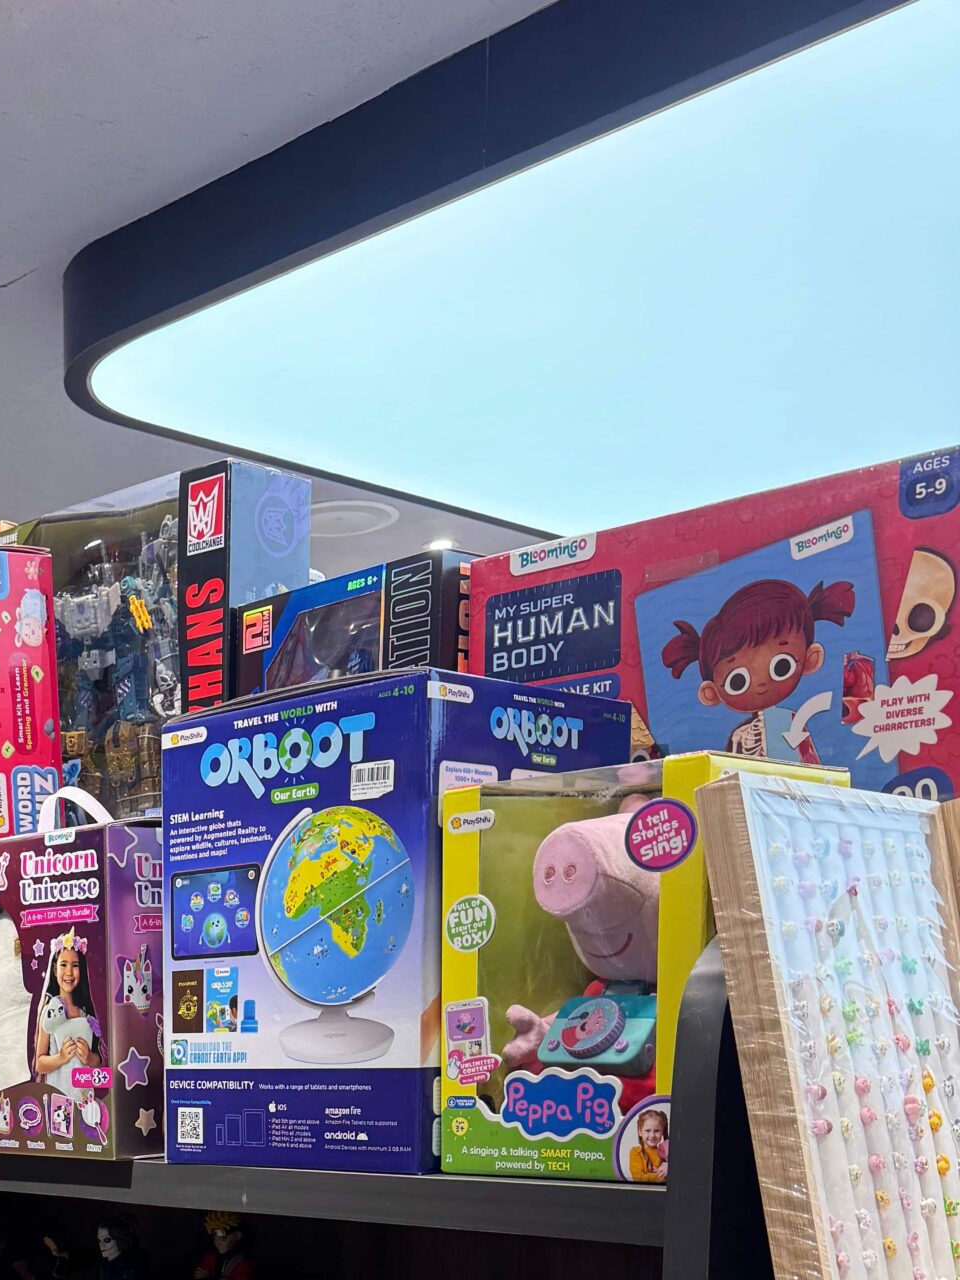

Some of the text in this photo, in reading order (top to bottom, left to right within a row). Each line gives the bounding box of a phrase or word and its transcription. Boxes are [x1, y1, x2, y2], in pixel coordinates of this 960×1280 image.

[913, 456, 950, 473] AGES
[915, 478, 947, 499] 5-9
[188, 536, 224, 553] COOLCHANGE
[347, 577, 366, 591] AGES
[495, 593, 574, 620] MY SUPER
[262, 611, 270, 645] FORM
[493, 600, 615, 648] HUMAN
[185, 577, 225, 714] HANS
[493, 641, 564, 673] BODY
[392, 685, 415, 697] 4-10
[447, 688, 470, 699] PlayShifu
[593, 680, 612, 694] KIT
[881, 693, 930, 708] PLAY WITH
[234, 700, 338, 729] TRAVEL THE WORLD WITH
[886, 706, 924, 719] DIVERSE
[490, 706, 584, 757] ORBOOT
[873, 717, 936, 733] CHARACTERS!
[180, 730, 203, 742] PlayShifu
[200, 712, 376, 799] ORBOOT
[274, 787, 316, 801] Our Earth
[17, 772, 31, 833] WORD
[170, 809, 225, 824] STEM Learning
[463, 816, 491, 827] PlayShifu
[646, 808, 668, 827] tell
[179, 822, 225, 834] interactive globe
[632, 820, 679, 844] Stories
[658, 829, 675, 842] and
[170, 826, 258, 846] powered Augmented Reality
[170, 834, 272, 853] explore cultures, landmarks,
[640, 829, 688, 862] Sing!
[170, 848, 228, 862] inventions maps!
[21, 850, 96, 876] Unicorn
[21, 880, 98, 903] Universe
[72, 909, 91, 917] Bundle
[453, 901, 469, 912] FULL
[449, 905, 488, 927] FUN
[451, 921, 486, 934] RIGHT OUT
[454, 931, 487, 949] BOX!
[190, 1042, 220, 1051] DOWNLOAD
[213, 1051, 247, 1063] EARTH APP!
[460, 1058, 495, 1072] UNLIMITED
[462, 1063, 495, 1075] CONTENT!
[74, 1068, 109, 1085] Ages 3+
[170, 1080, 254, 1090] DEVICE COMPATIBILITY
[339, 1084, 371, 1092] smartphones
[325, 1106, 361, 1117] amazon fire
[508, 1082, 612, 1128] Peppa Pig
[325, 1131, 355, 1140] android
[461, 1145, 605, 1161] A singing talking SMART Peppa,
[496, 1160, 570, 1172] powered by TECH
